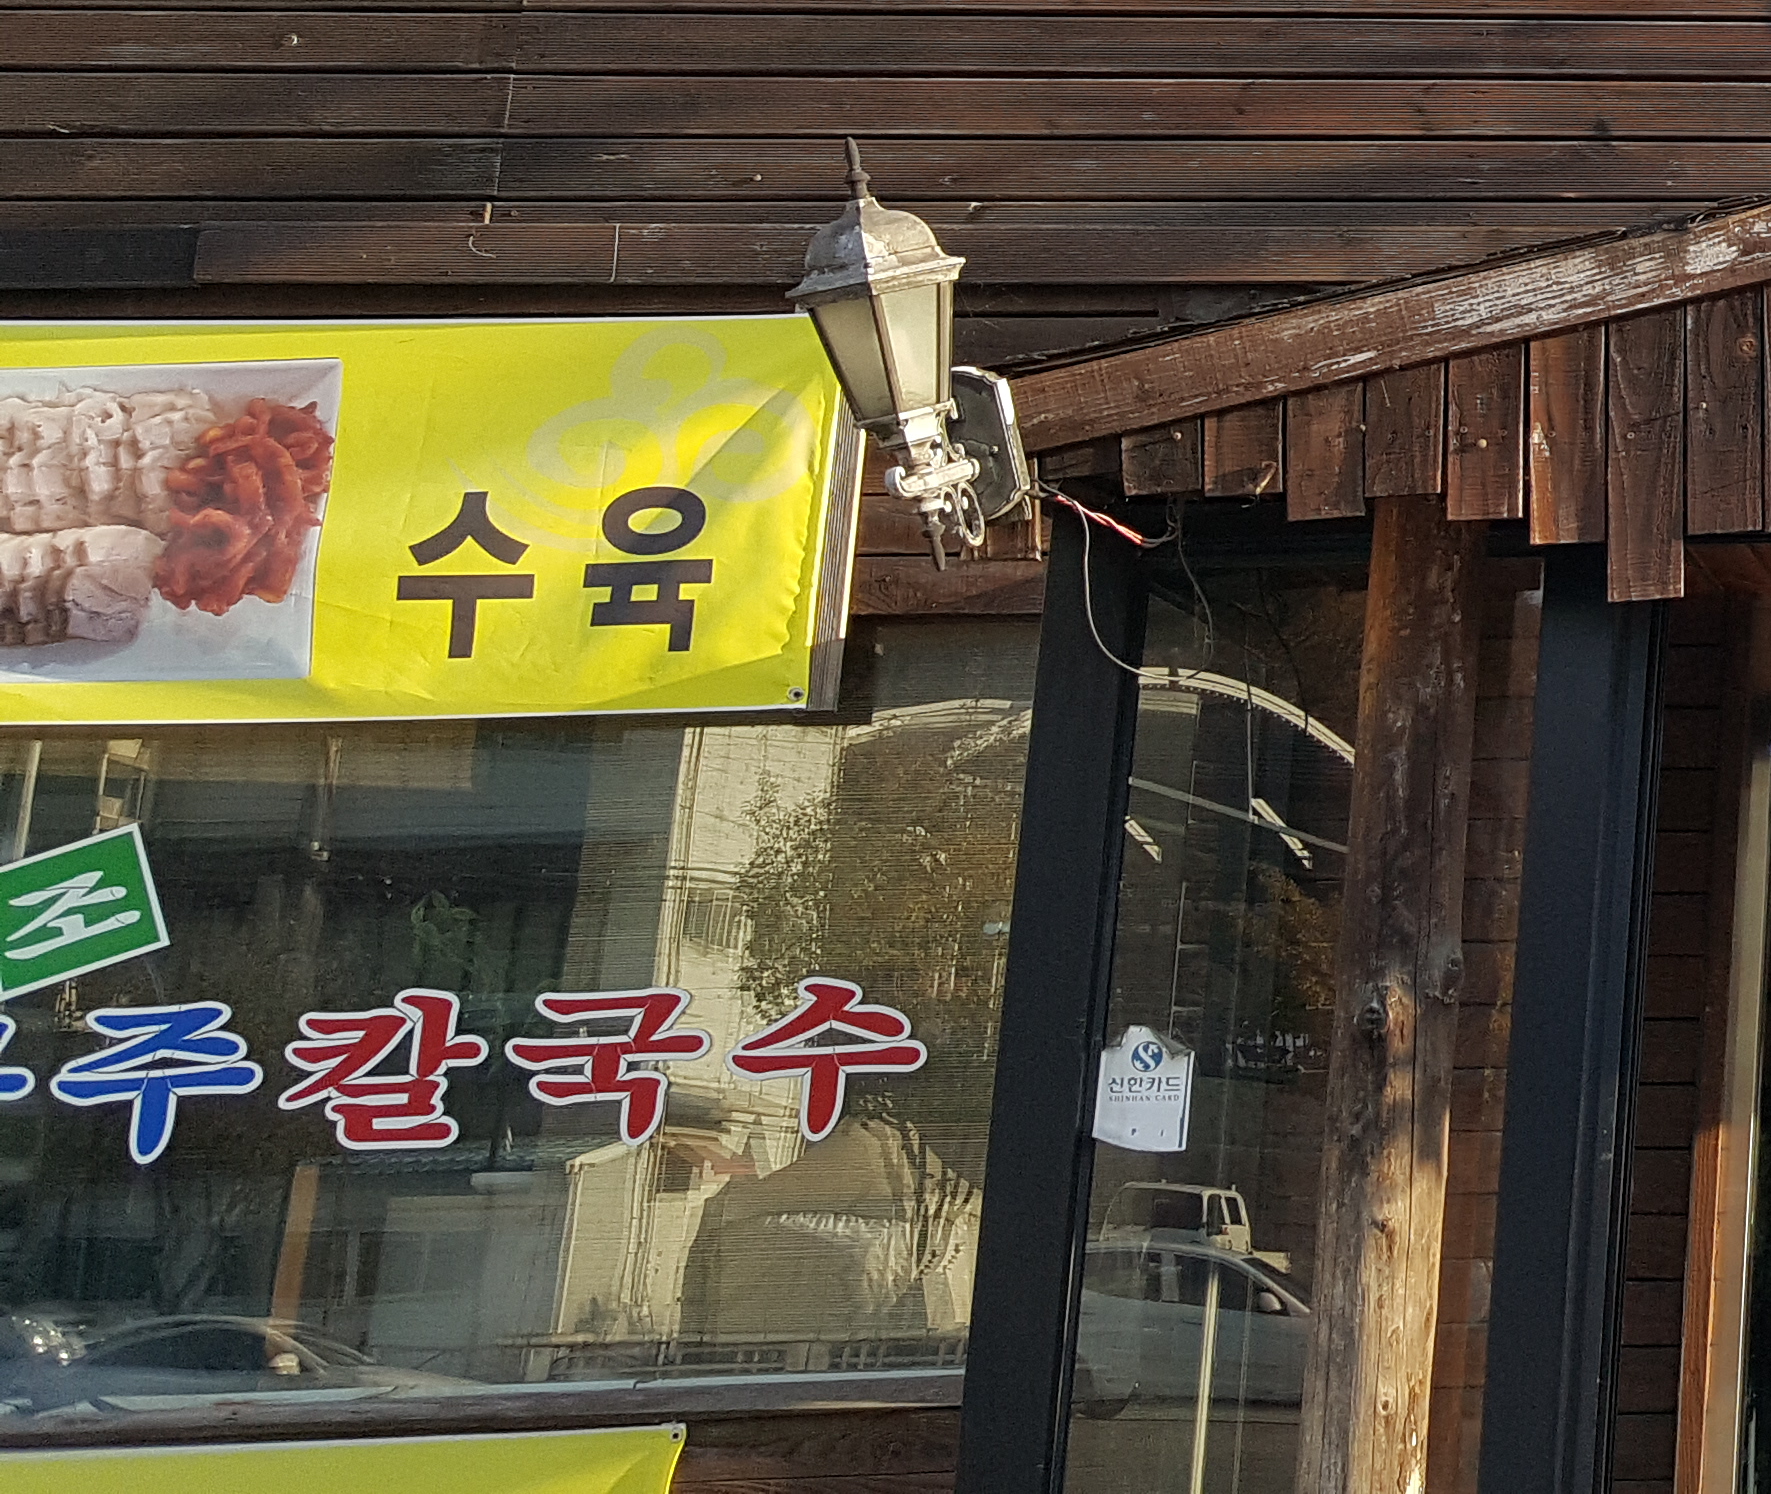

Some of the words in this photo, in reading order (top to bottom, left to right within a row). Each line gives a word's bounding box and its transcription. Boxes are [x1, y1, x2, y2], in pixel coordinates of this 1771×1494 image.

[395, 485, 715, 659] 수육
[4, 870, 142, 961] 조
[0, 975, 928, 1166] 주칼국수
[1107, 1076, 1181, 1094] 신한카드
[1154, 1093, 1180, 1102] CARD
